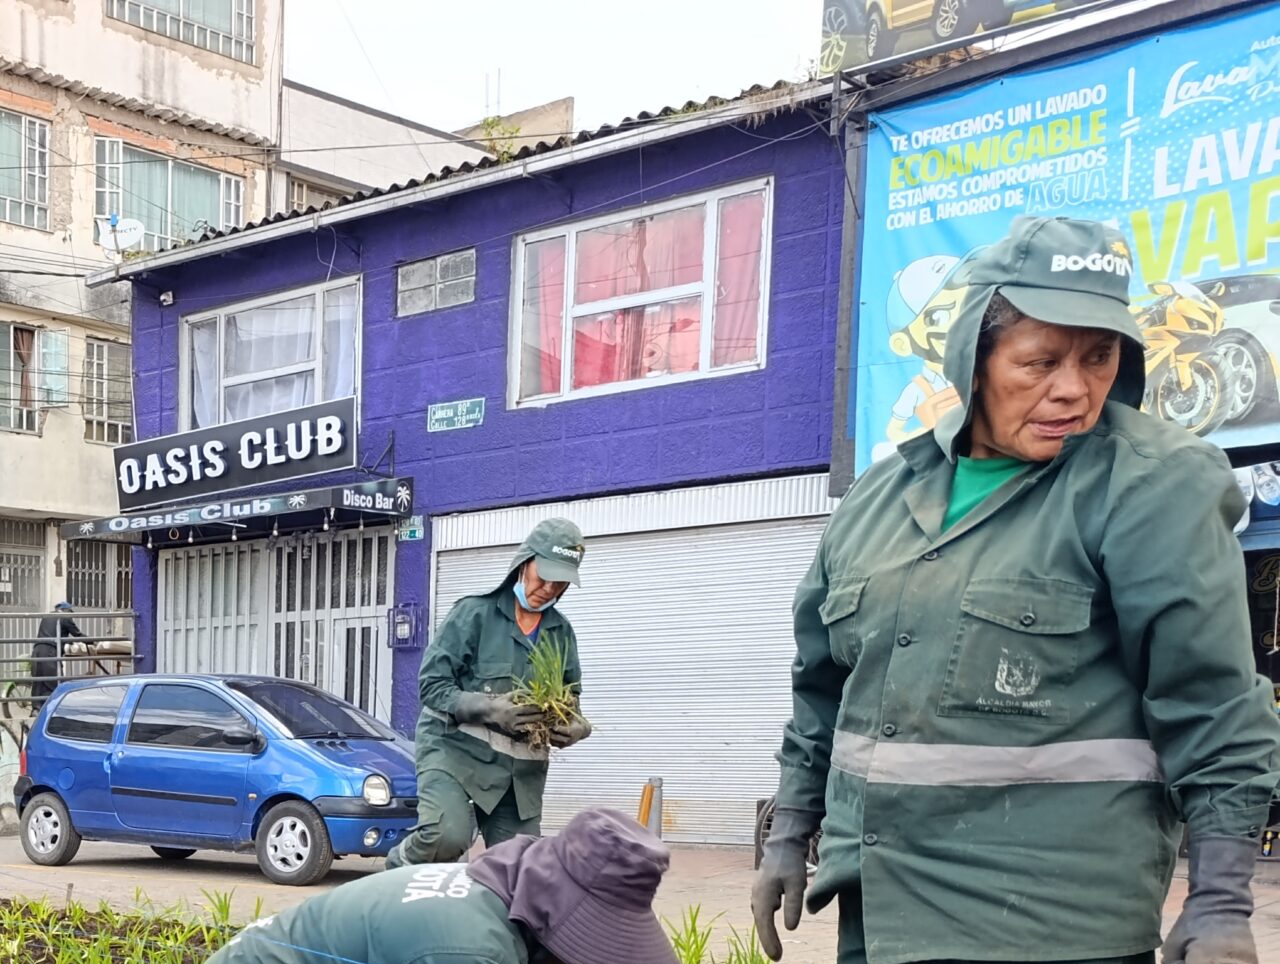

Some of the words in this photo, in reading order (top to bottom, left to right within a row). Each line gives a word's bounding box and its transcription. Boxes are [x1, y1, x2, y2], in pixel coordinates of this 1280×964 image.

[889, 108, 1108, 191] ECOAMIGABLE
[890, 134, 908, 152] TE
[911, 110, 1005, 150] OFRECEMOS
[1007, 103, 1032, 126] UN
[1035, 84, 1107, 120] LAVADO
[886, 209, 917, 231] CON
[919, 206, 934, 225] EL
[936, 193, 1001, 221] AHORRO
[1004, 187, 1024, 208] DE
[1025, 167, 1108, 214] AGUA
[888, 181, 958, 211] ESTAMOS
[961, 146, 1108, 197] COMPROMETIDOS
[119, 440, 226, 495] OASIS
[239, 415, 344, 470] CLUB
[108, 510, 190, 532] Oasis
[201, 499, 271, 521] Club
[342, 488, 373, 509] Disco
[374, 492, 394, 511] Bar
